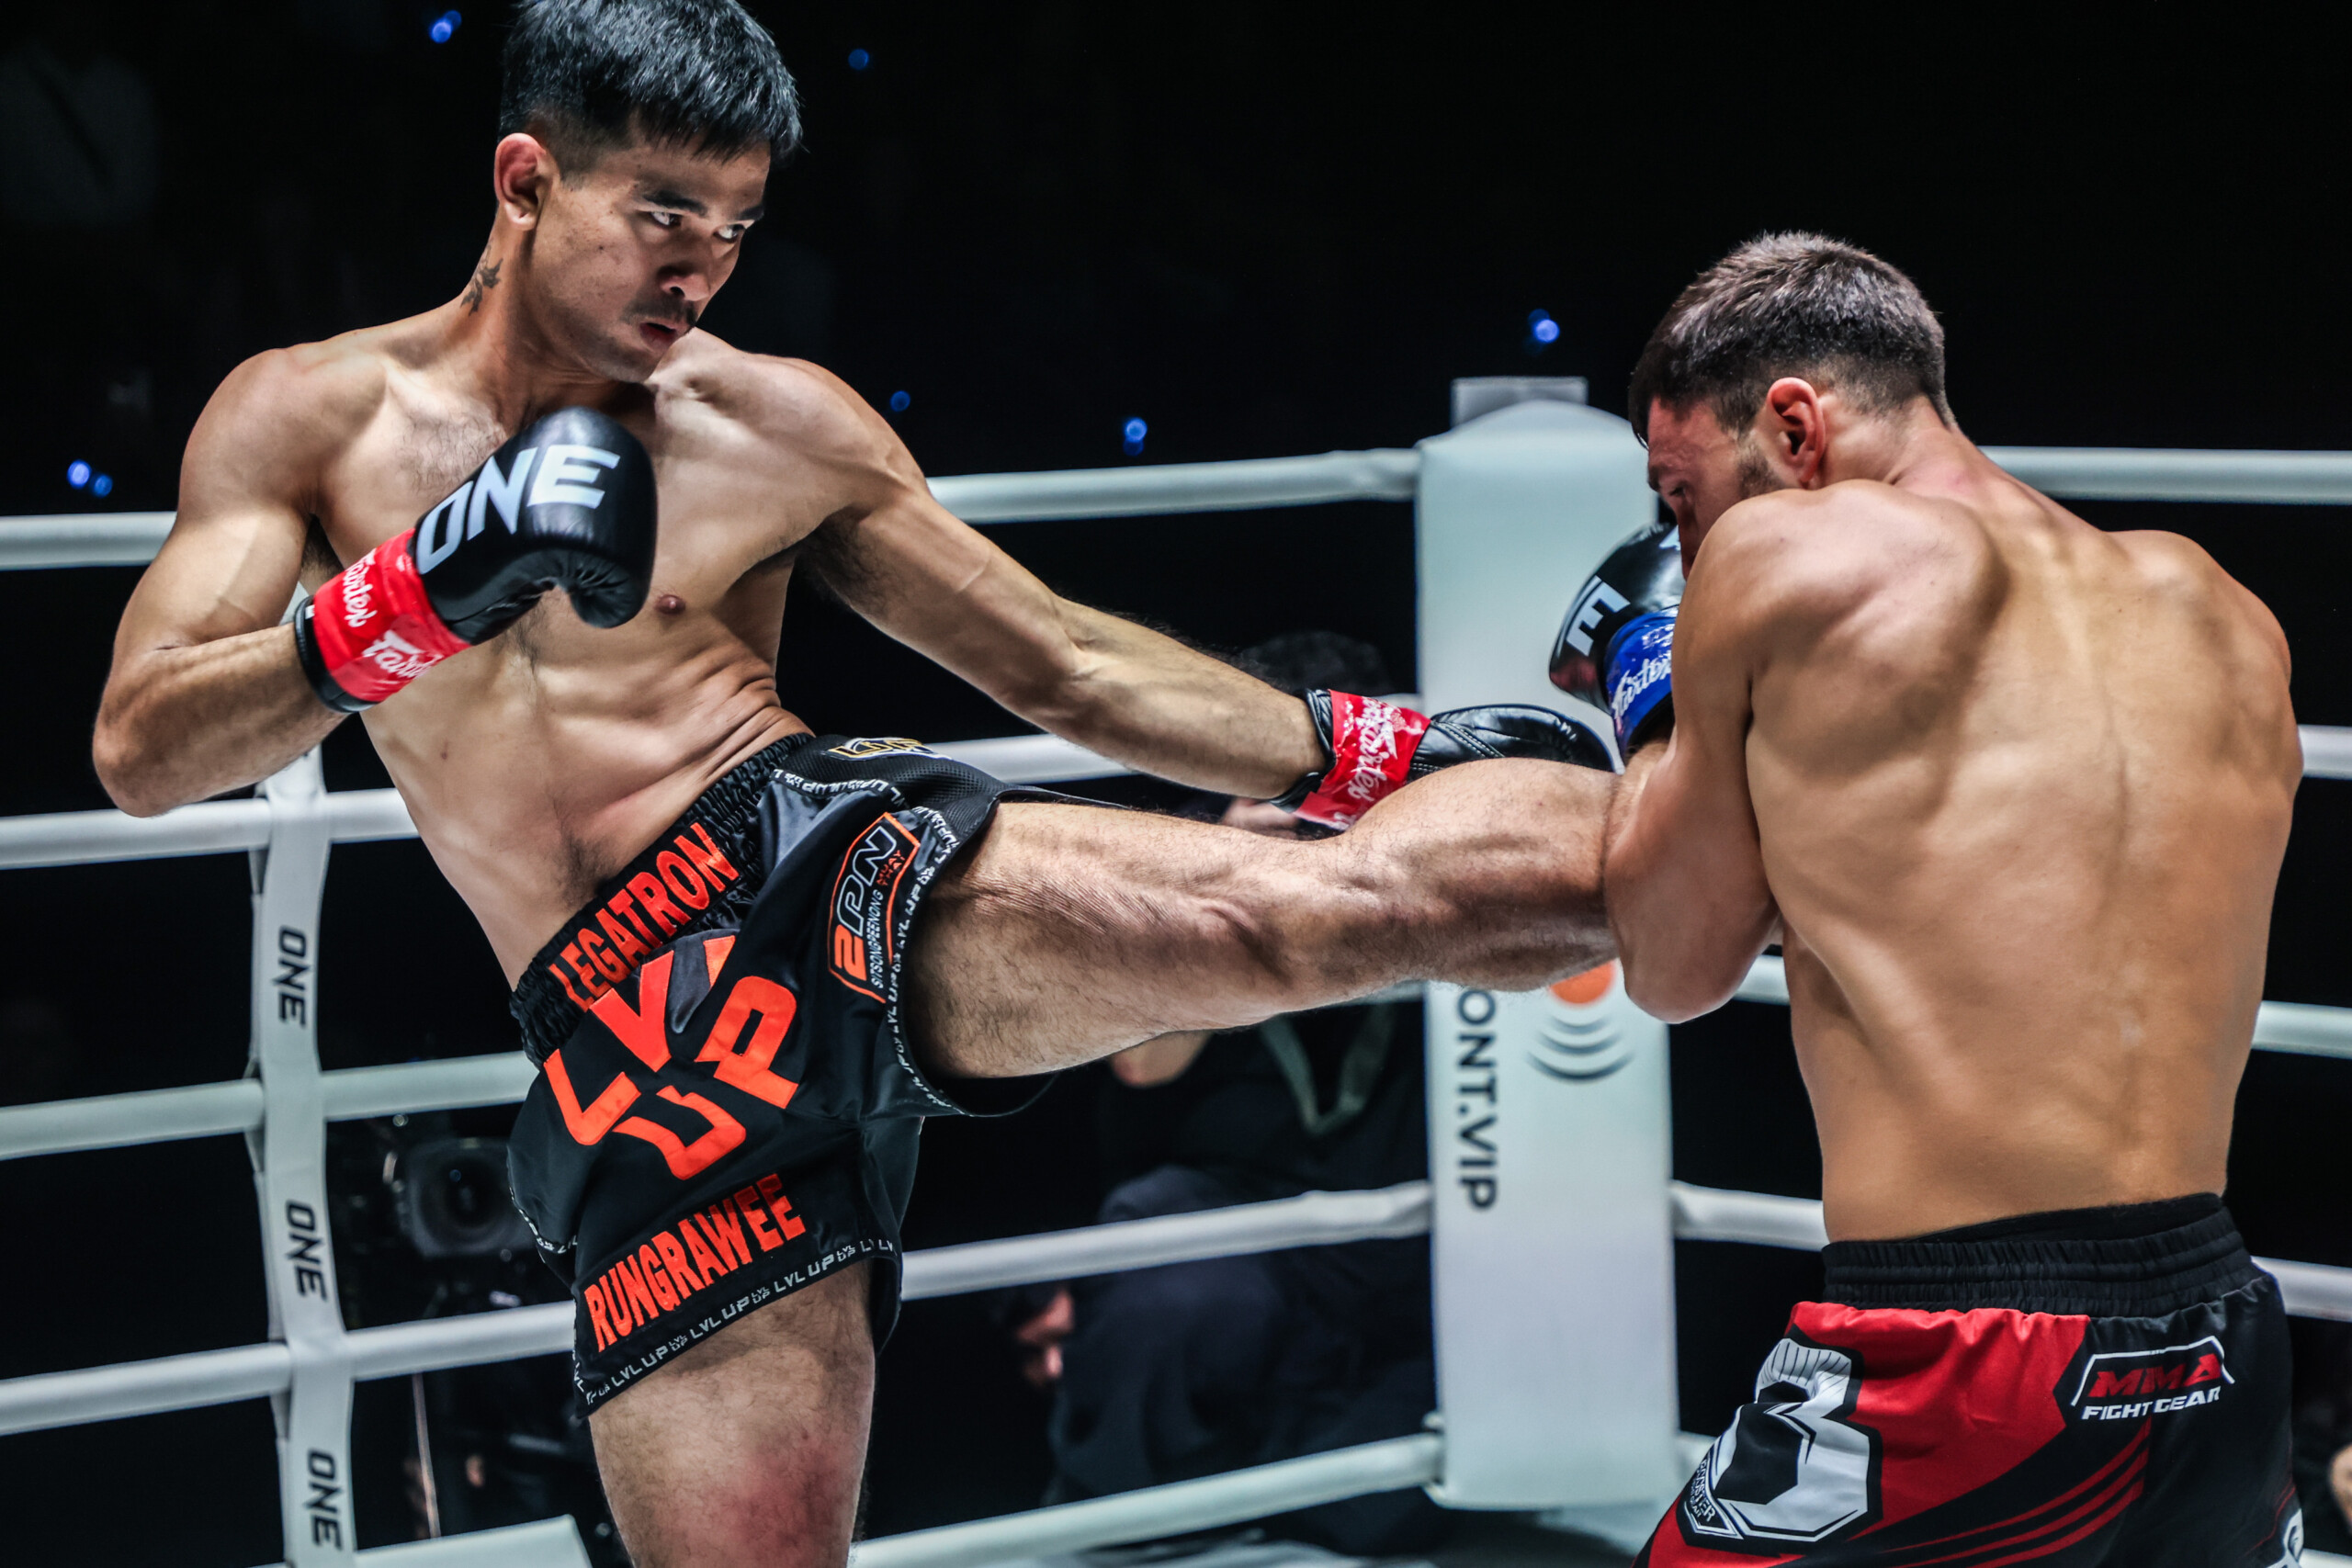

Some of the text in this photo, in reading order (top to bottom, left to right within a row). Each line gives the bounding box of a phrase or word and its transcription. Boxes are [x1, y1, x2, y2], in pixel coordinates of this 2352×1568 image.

[415, 445, 620, 575] ONE
[548, 822, 739, 1012] LEGATRON
[834, 826, 897, 981] 2PN
[273, 927, 307, 1028] ONE
[613, 975, 797, 1180] UP
[284, 1201, 326, 1302] ONE
[584, 1174, 806, 1353] RUNGRAWEE
[611, 1364, 642, 1387] LVL
[641, 1345, 668, 1368] UP
[689, 1317, 721, 1339] LVL
[721, 1296, 750, 1320] UP
[774, 1271, 806, 1292] LVL
[808, 1254, 834, 1277] UP
[2087, 1353, 2222, 1397] MMA
[2081, 1386, 2221, 1420] FIGHT GEAR
[304, 1449, 344, 1551] ONE
